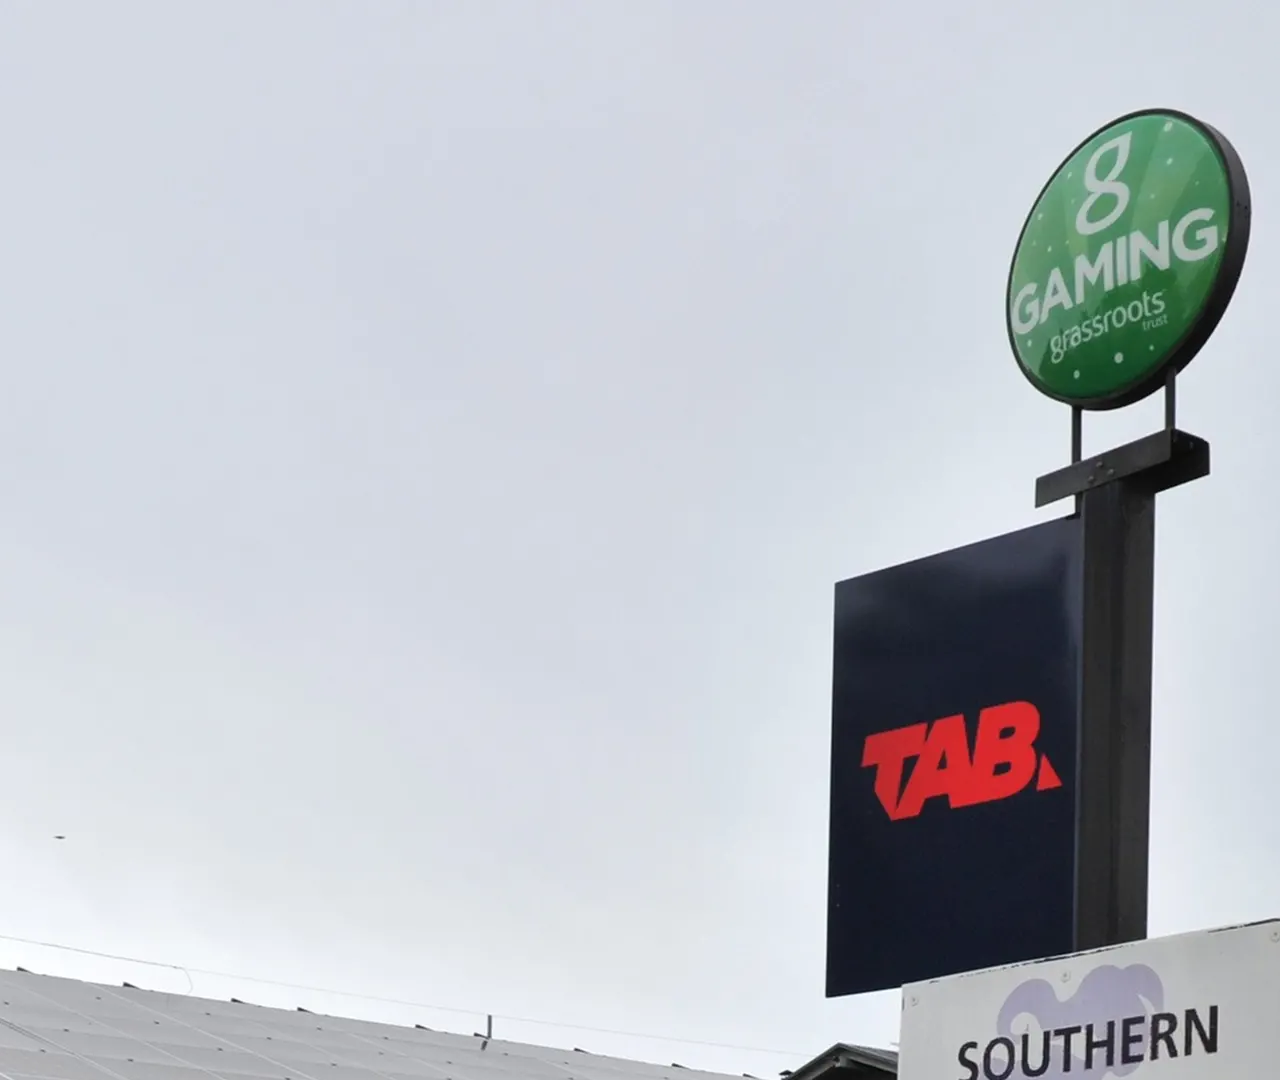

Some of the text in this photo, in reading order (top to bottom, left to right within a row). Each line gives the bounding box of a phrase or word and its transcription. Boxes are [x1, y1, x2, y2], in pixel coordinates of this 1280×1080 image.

[1075, 131, 1132, 236] 8
[1010, 207, 1218, 334] GAMING
[1050, 290, 1166, 364] grassroots
[861, 700, 1041, 821] TAB
